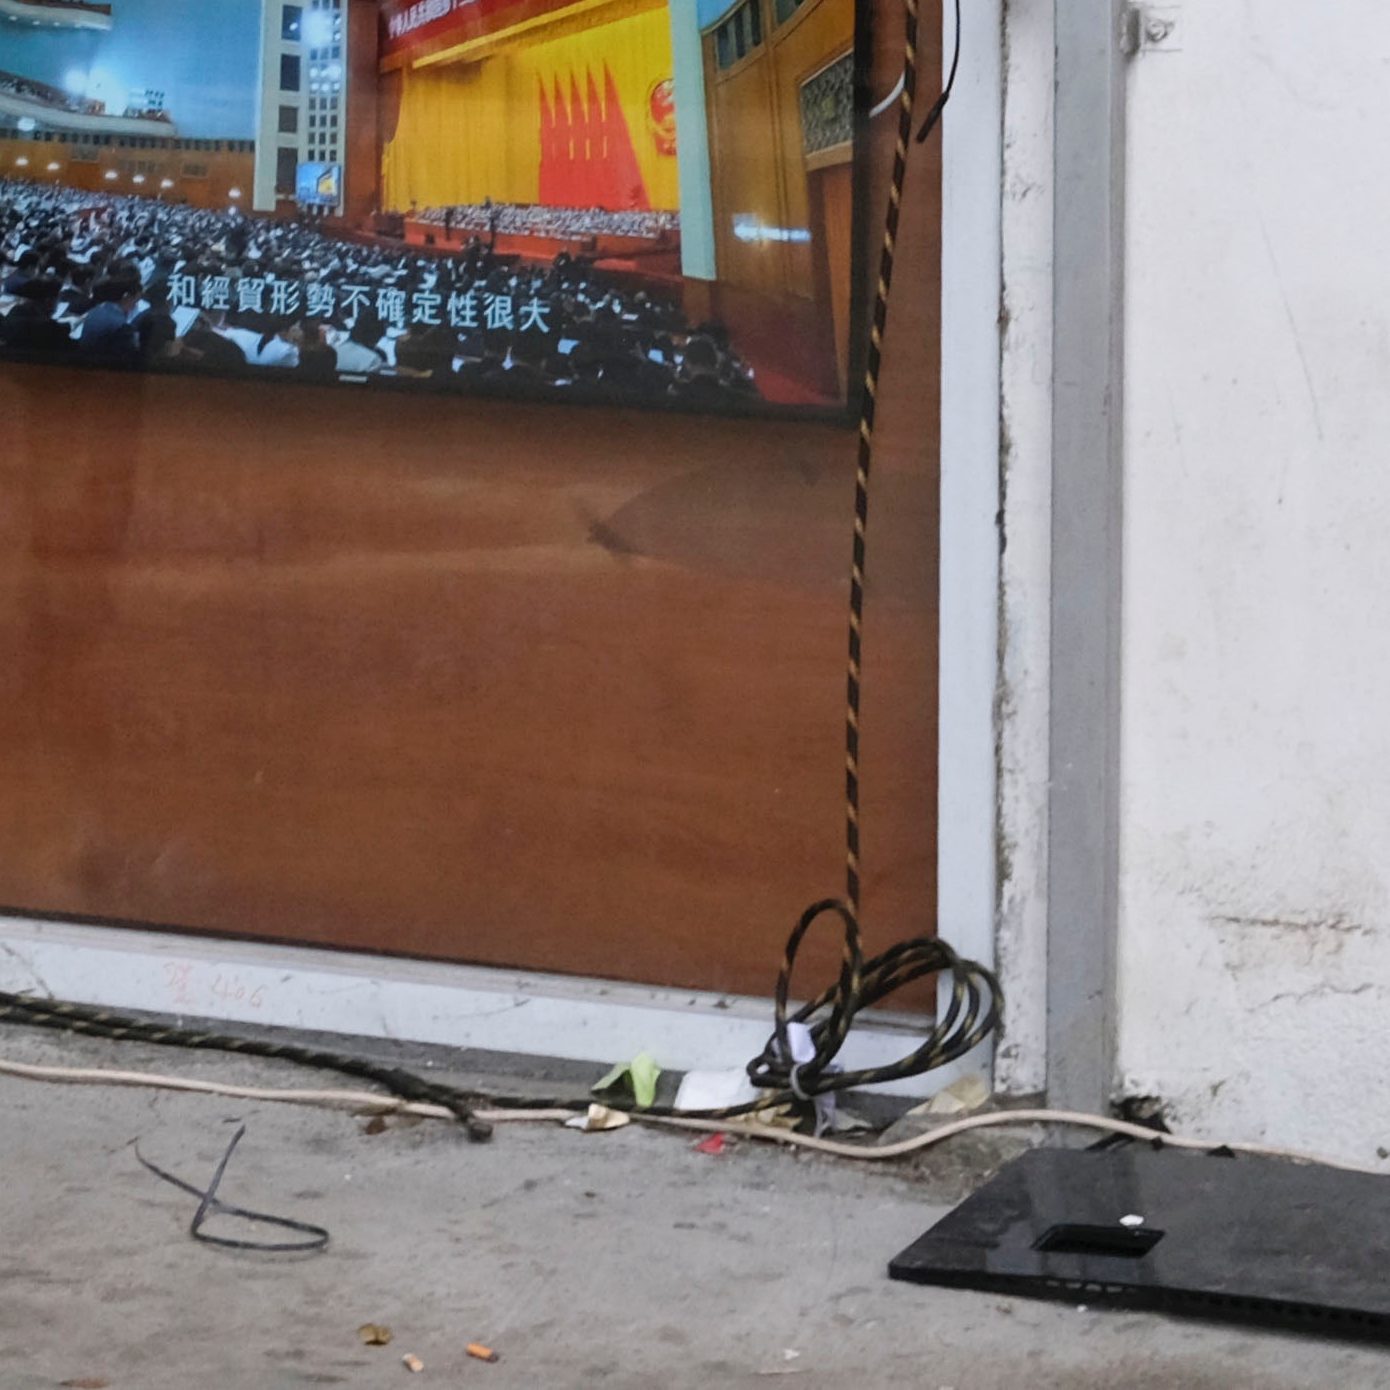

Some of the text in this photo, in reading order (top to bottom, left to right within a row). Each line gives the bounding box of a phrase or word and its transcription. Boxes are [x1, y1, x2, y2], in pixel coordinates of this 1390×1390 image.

[165, 273, 552, 334] 和經貿形勢不確定性很大
